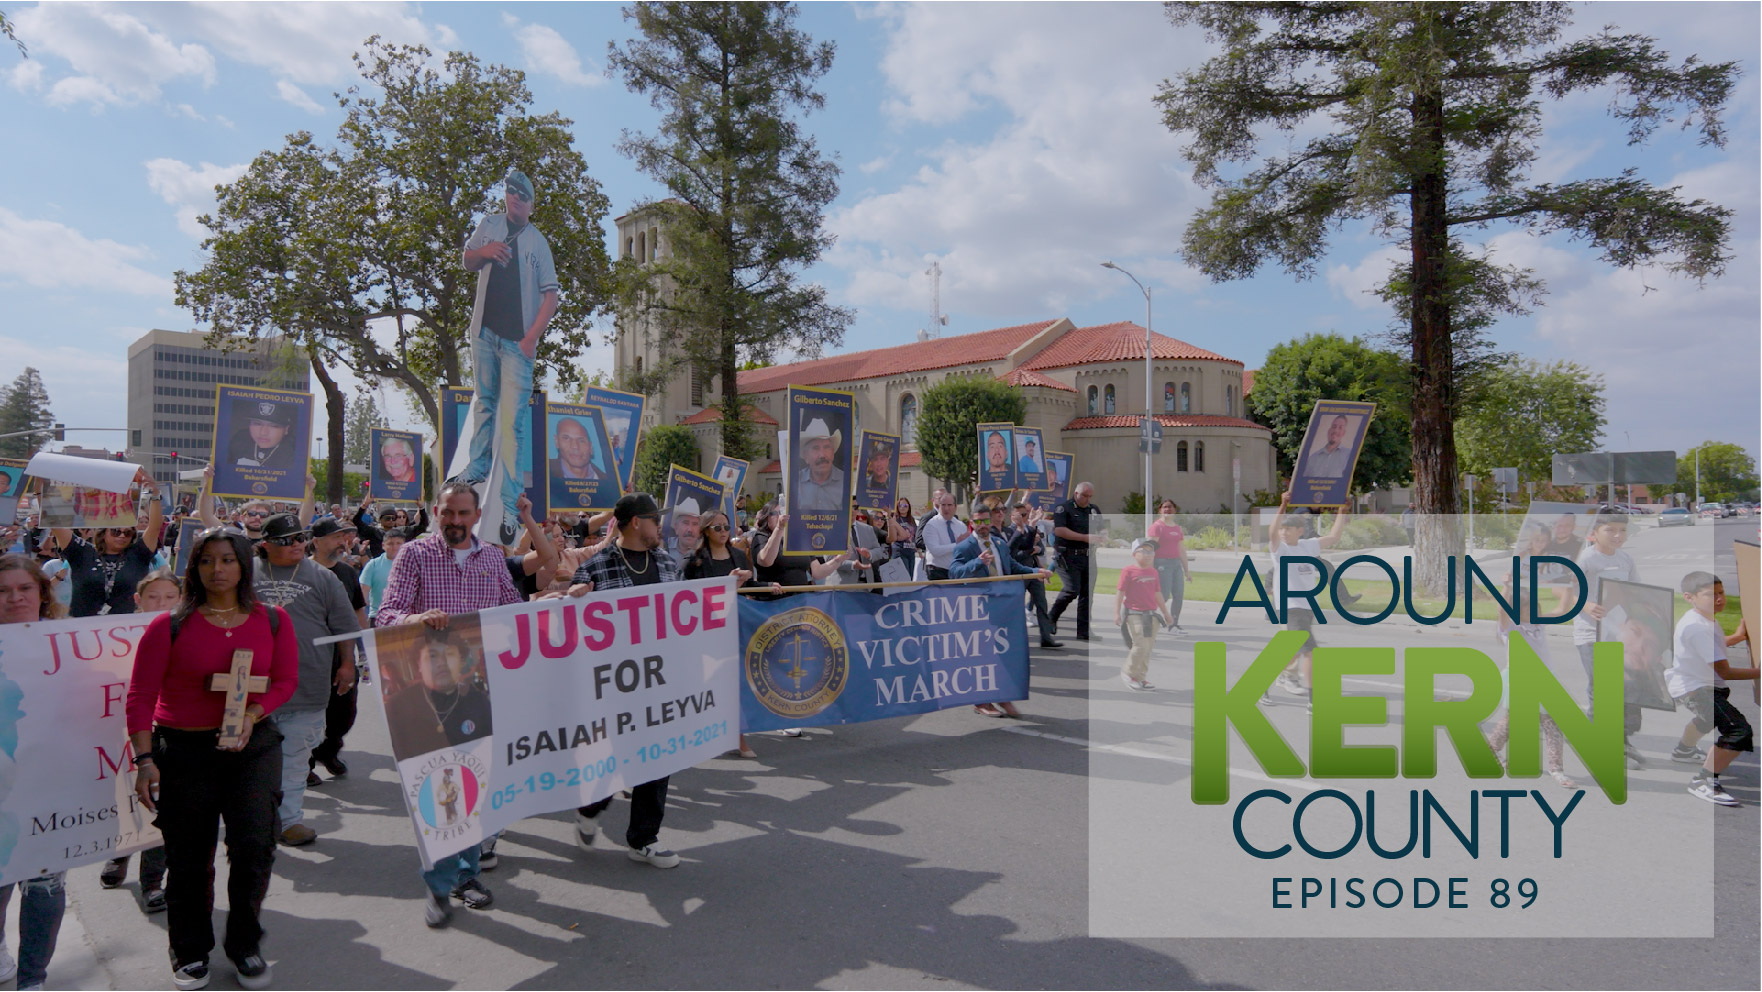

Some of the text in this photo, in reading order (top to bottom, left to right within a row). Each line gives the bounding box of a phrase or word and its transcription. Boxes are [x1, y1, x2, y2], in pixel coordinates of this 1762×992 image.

[227, 390, 305, 405] ISAIAH PEDRO LEYVA
[793, 394, 850, 408] Gilberto Sanchez
[243, 474, 278, 482] Bakersfield
[674, 473, 721, 496] Gilberto Sanchez
[497, 585, 727, 670] JUSTICE
[874, 595, 990, 630] CRIME
[755, 613, 842, 650] DISTRICT ATTORNEY
[856, 627, 1010, 670] VICTIM'S
[593, 655, 666, 700] FOR
[873, 664, 1000, 706] MARCH
[767, 690, 830, 712] KERN COUNTY
[507, 690, 716, 766] ISAIAH P. LEYVA
[410, 752, 485, 798] PASCUA YAQUI
[491, 756, 617, 810] 05-19-2000
[636, 720, 728, 764] 10-31-2021
[32, 803, 119, 836] Moises
[435, 821, 472, 841] TRIBE
